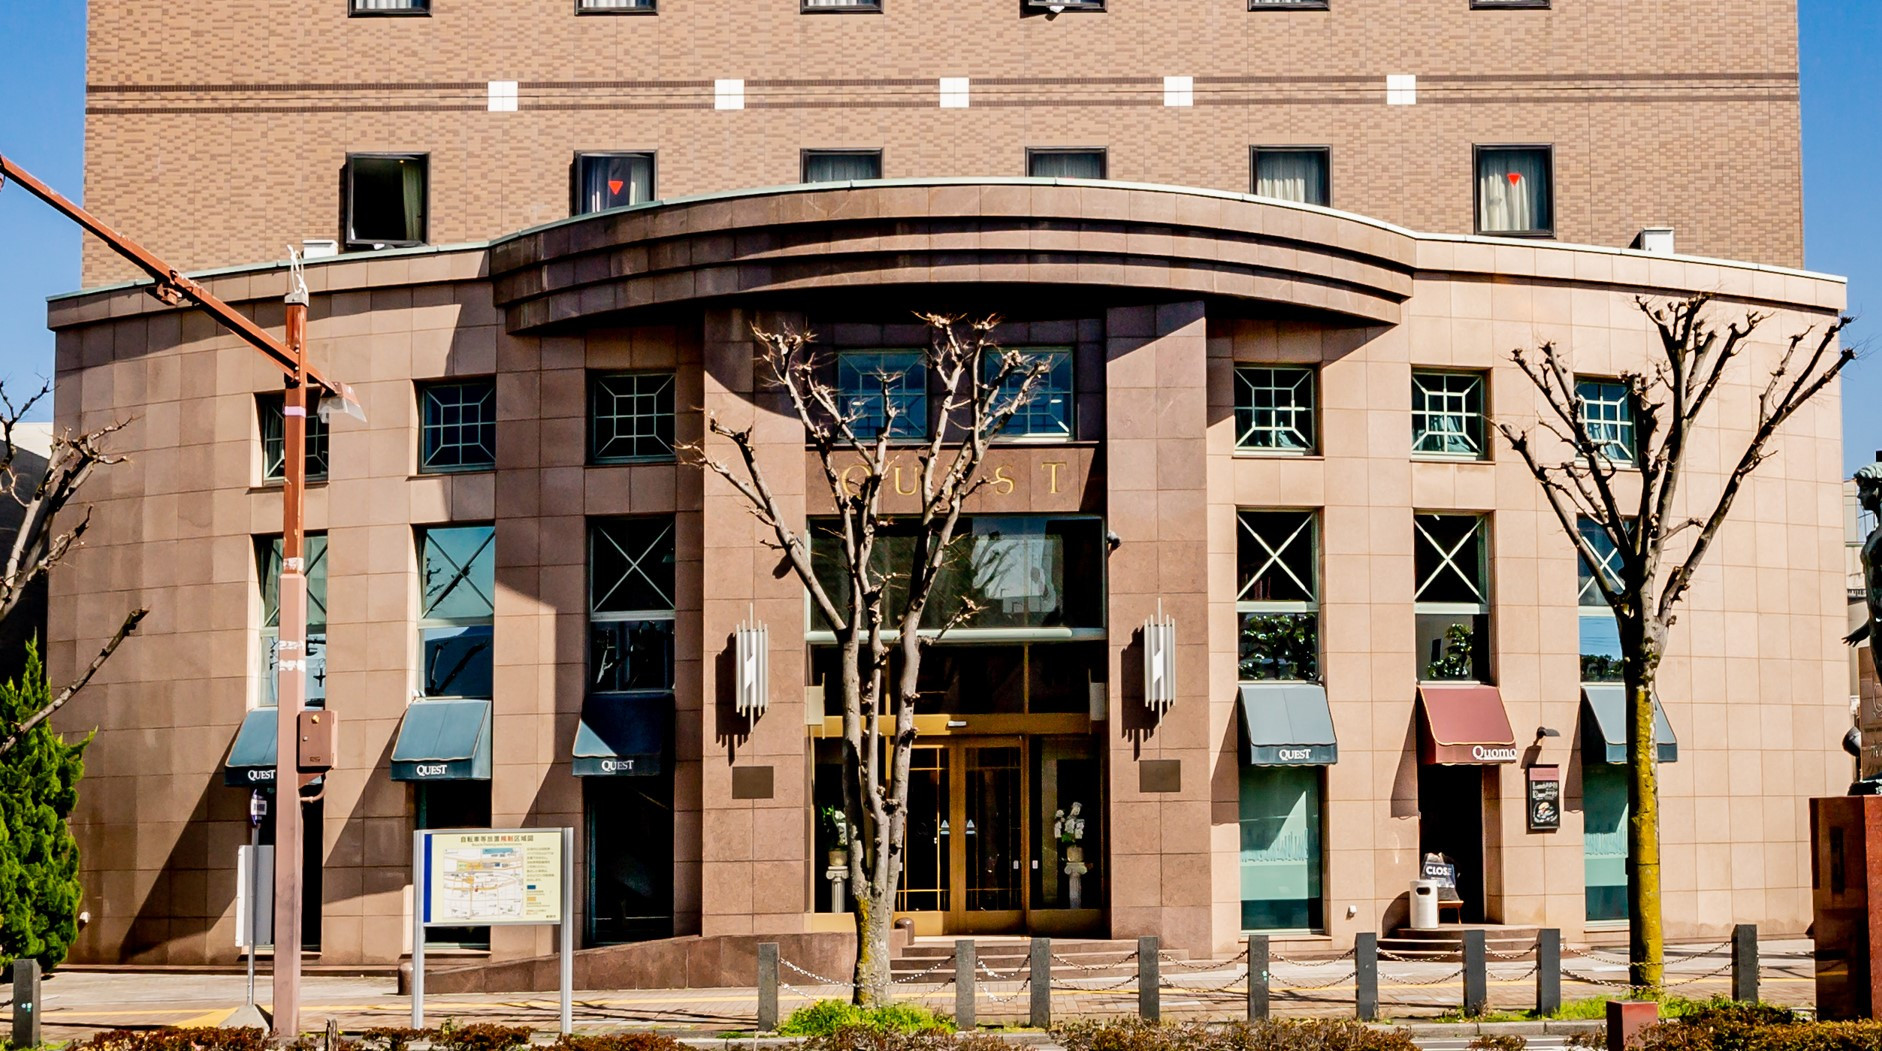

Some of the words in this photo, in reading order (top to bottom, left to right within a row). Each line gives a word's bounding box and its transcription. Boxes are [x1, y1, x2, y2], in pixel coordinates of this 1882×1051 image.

[840, 461, 1067, 499] QUST
[1279, 749, 1312, 761] QUEST
[1472, 745, 1517, 760] Quomo
[416, 764, 448, 777] QUEST
[601, 760, 634, 772] QUEST
[247, 769, 276, 781] QUEST
